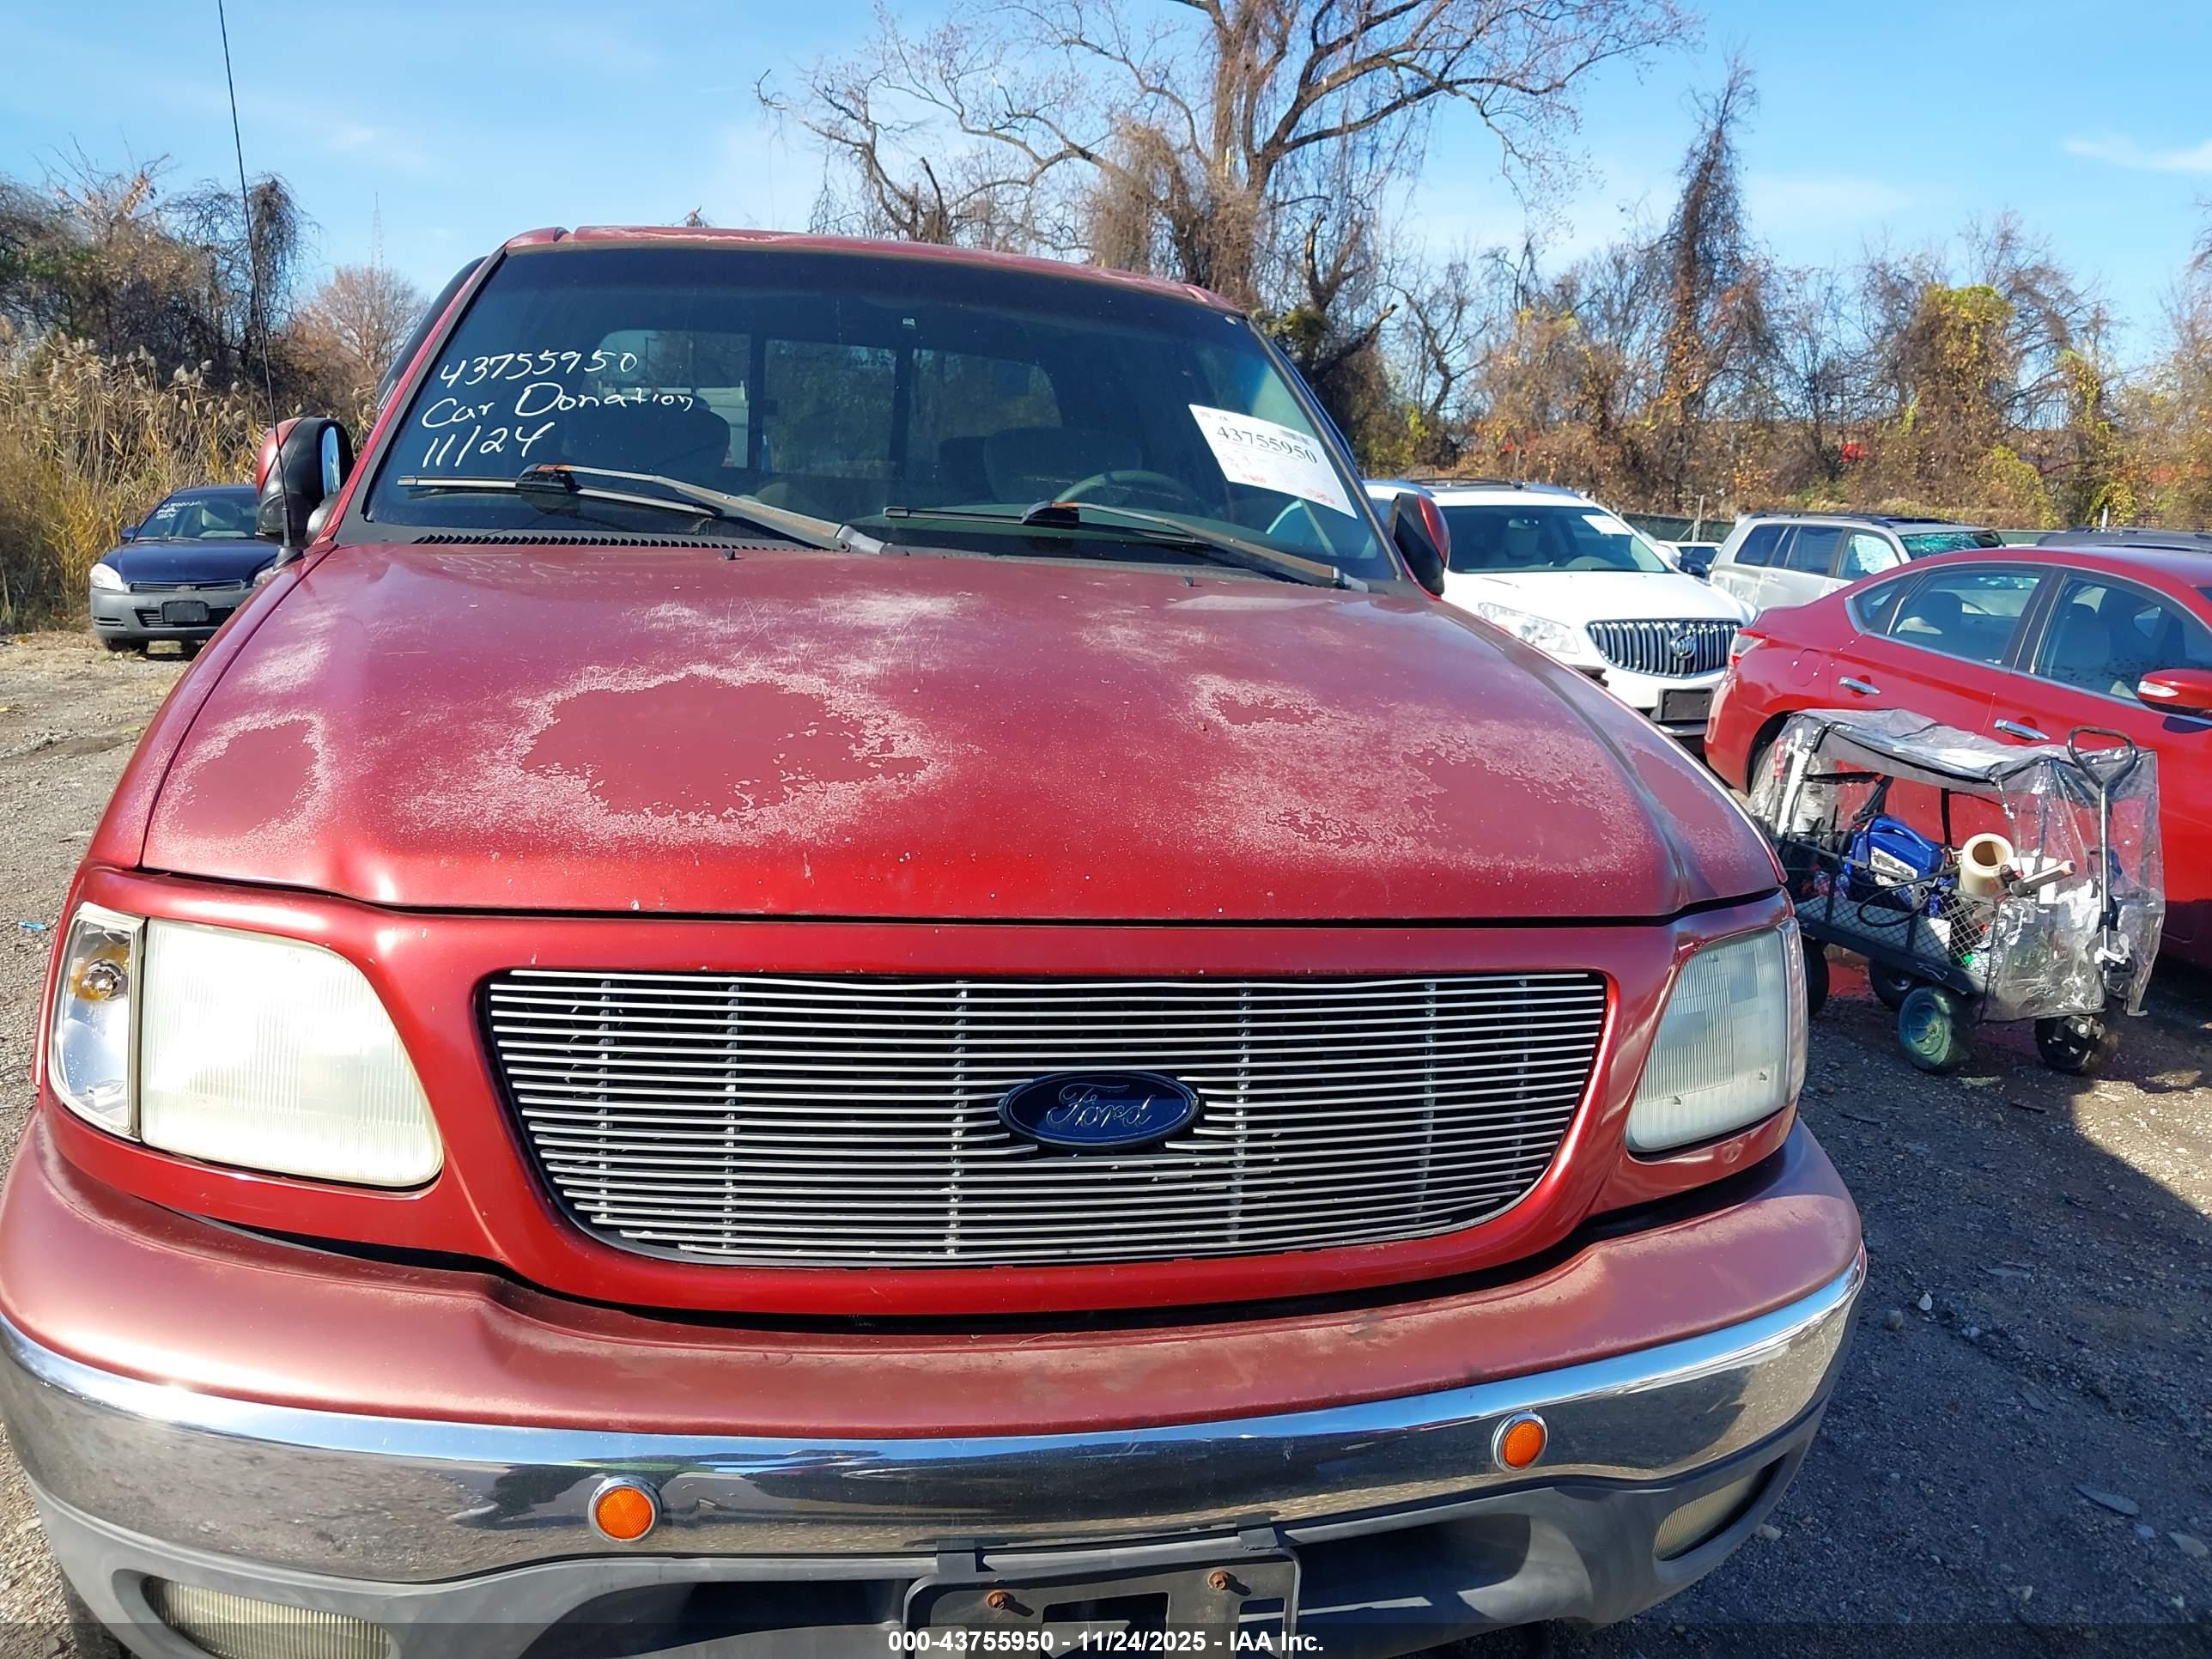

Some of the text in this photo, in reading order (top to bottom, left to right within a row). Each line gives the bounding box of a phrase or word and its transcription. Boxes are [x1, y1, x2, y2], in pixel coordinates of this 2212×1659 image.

[440, 349, 638, 388] 43755950
[421, 381, 694, 428] Car Donation
[422, 421, 556, 468] 11/24
[1217, 426, 1318, 465] 43755950
[1046, 1083, 1156, 1128] Ford
